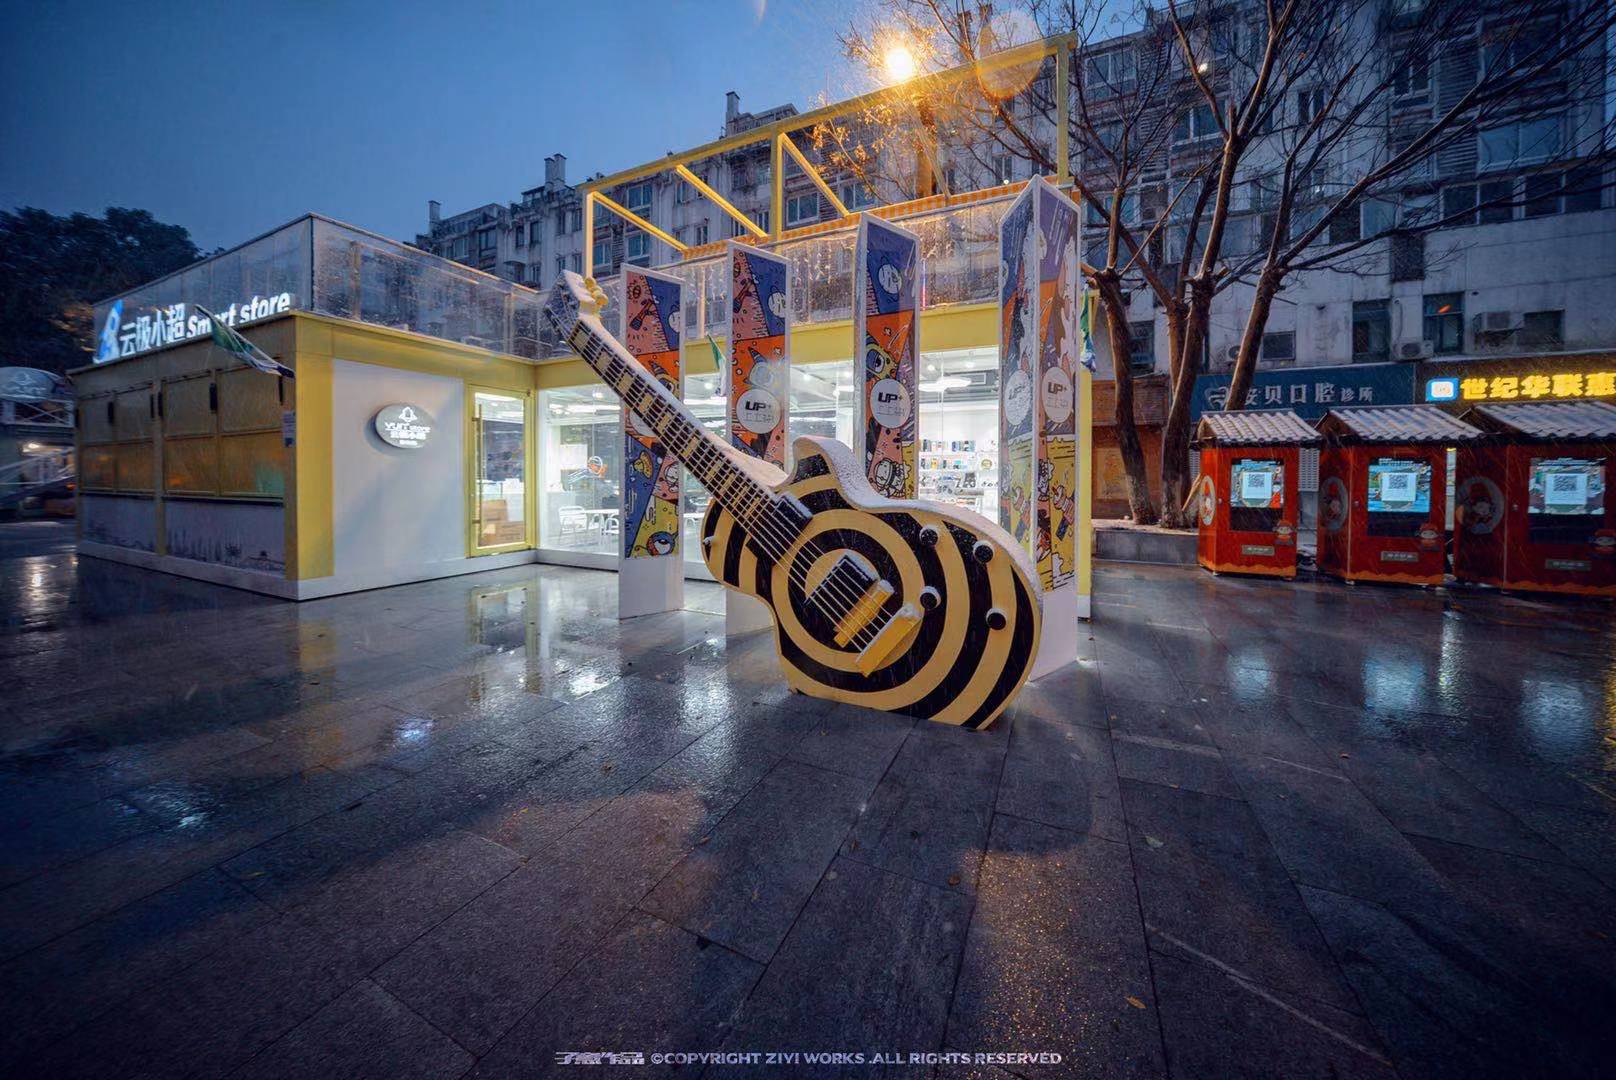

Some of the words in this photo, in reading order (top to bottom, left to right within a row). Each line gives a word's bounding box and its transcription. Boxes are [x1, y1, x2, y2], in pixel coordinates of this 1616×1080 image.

[119, 303, 186, 356] 云极小超
[187, 303, 237, 338] Smrt
[239, 292, 290, 323] store
